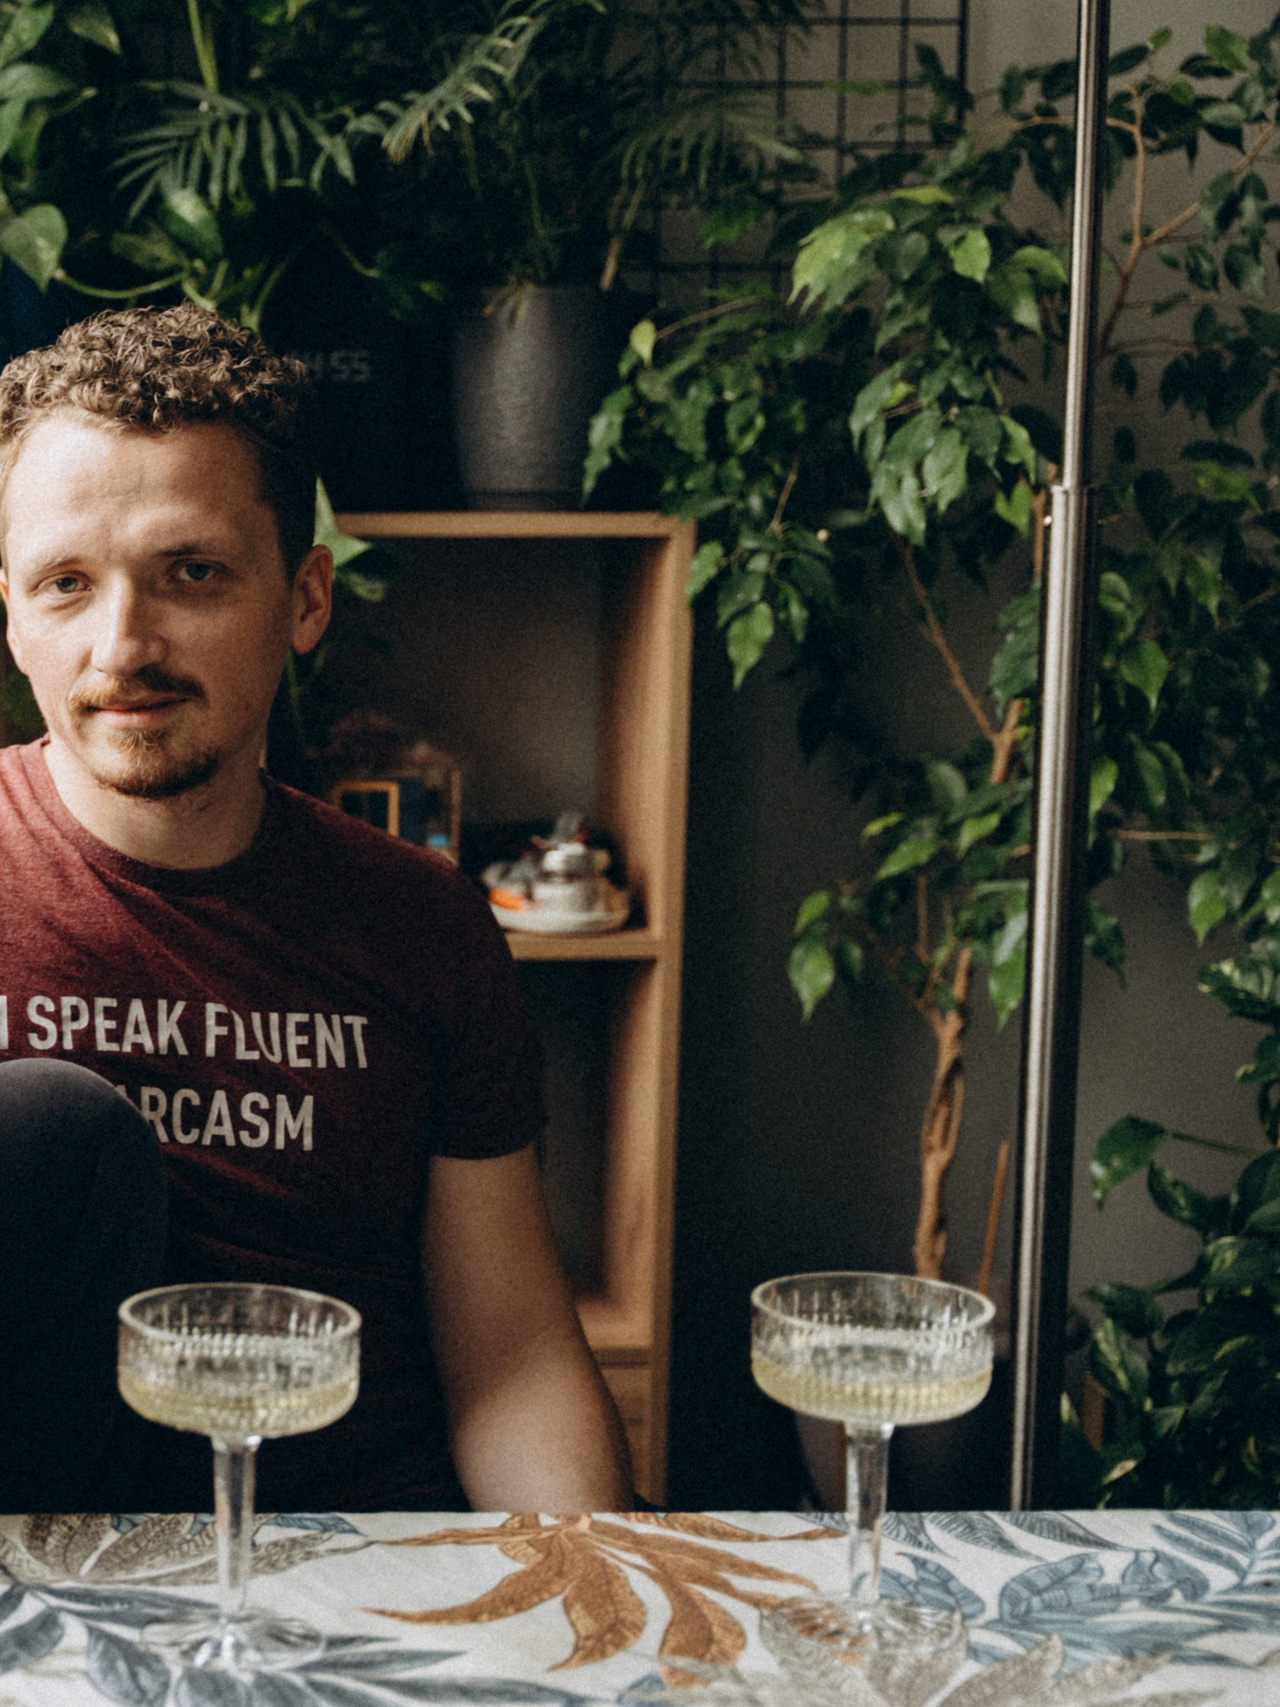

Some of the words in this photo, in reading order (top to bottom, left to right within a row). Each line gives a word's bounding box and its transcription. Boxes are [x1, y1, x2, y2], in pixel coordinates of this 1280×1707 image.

[25, 994, 189, 1056] SPEAK
[205, 1001, 369, 1069] FLUENT
[114, 1084, 315, 1151] RCASM
